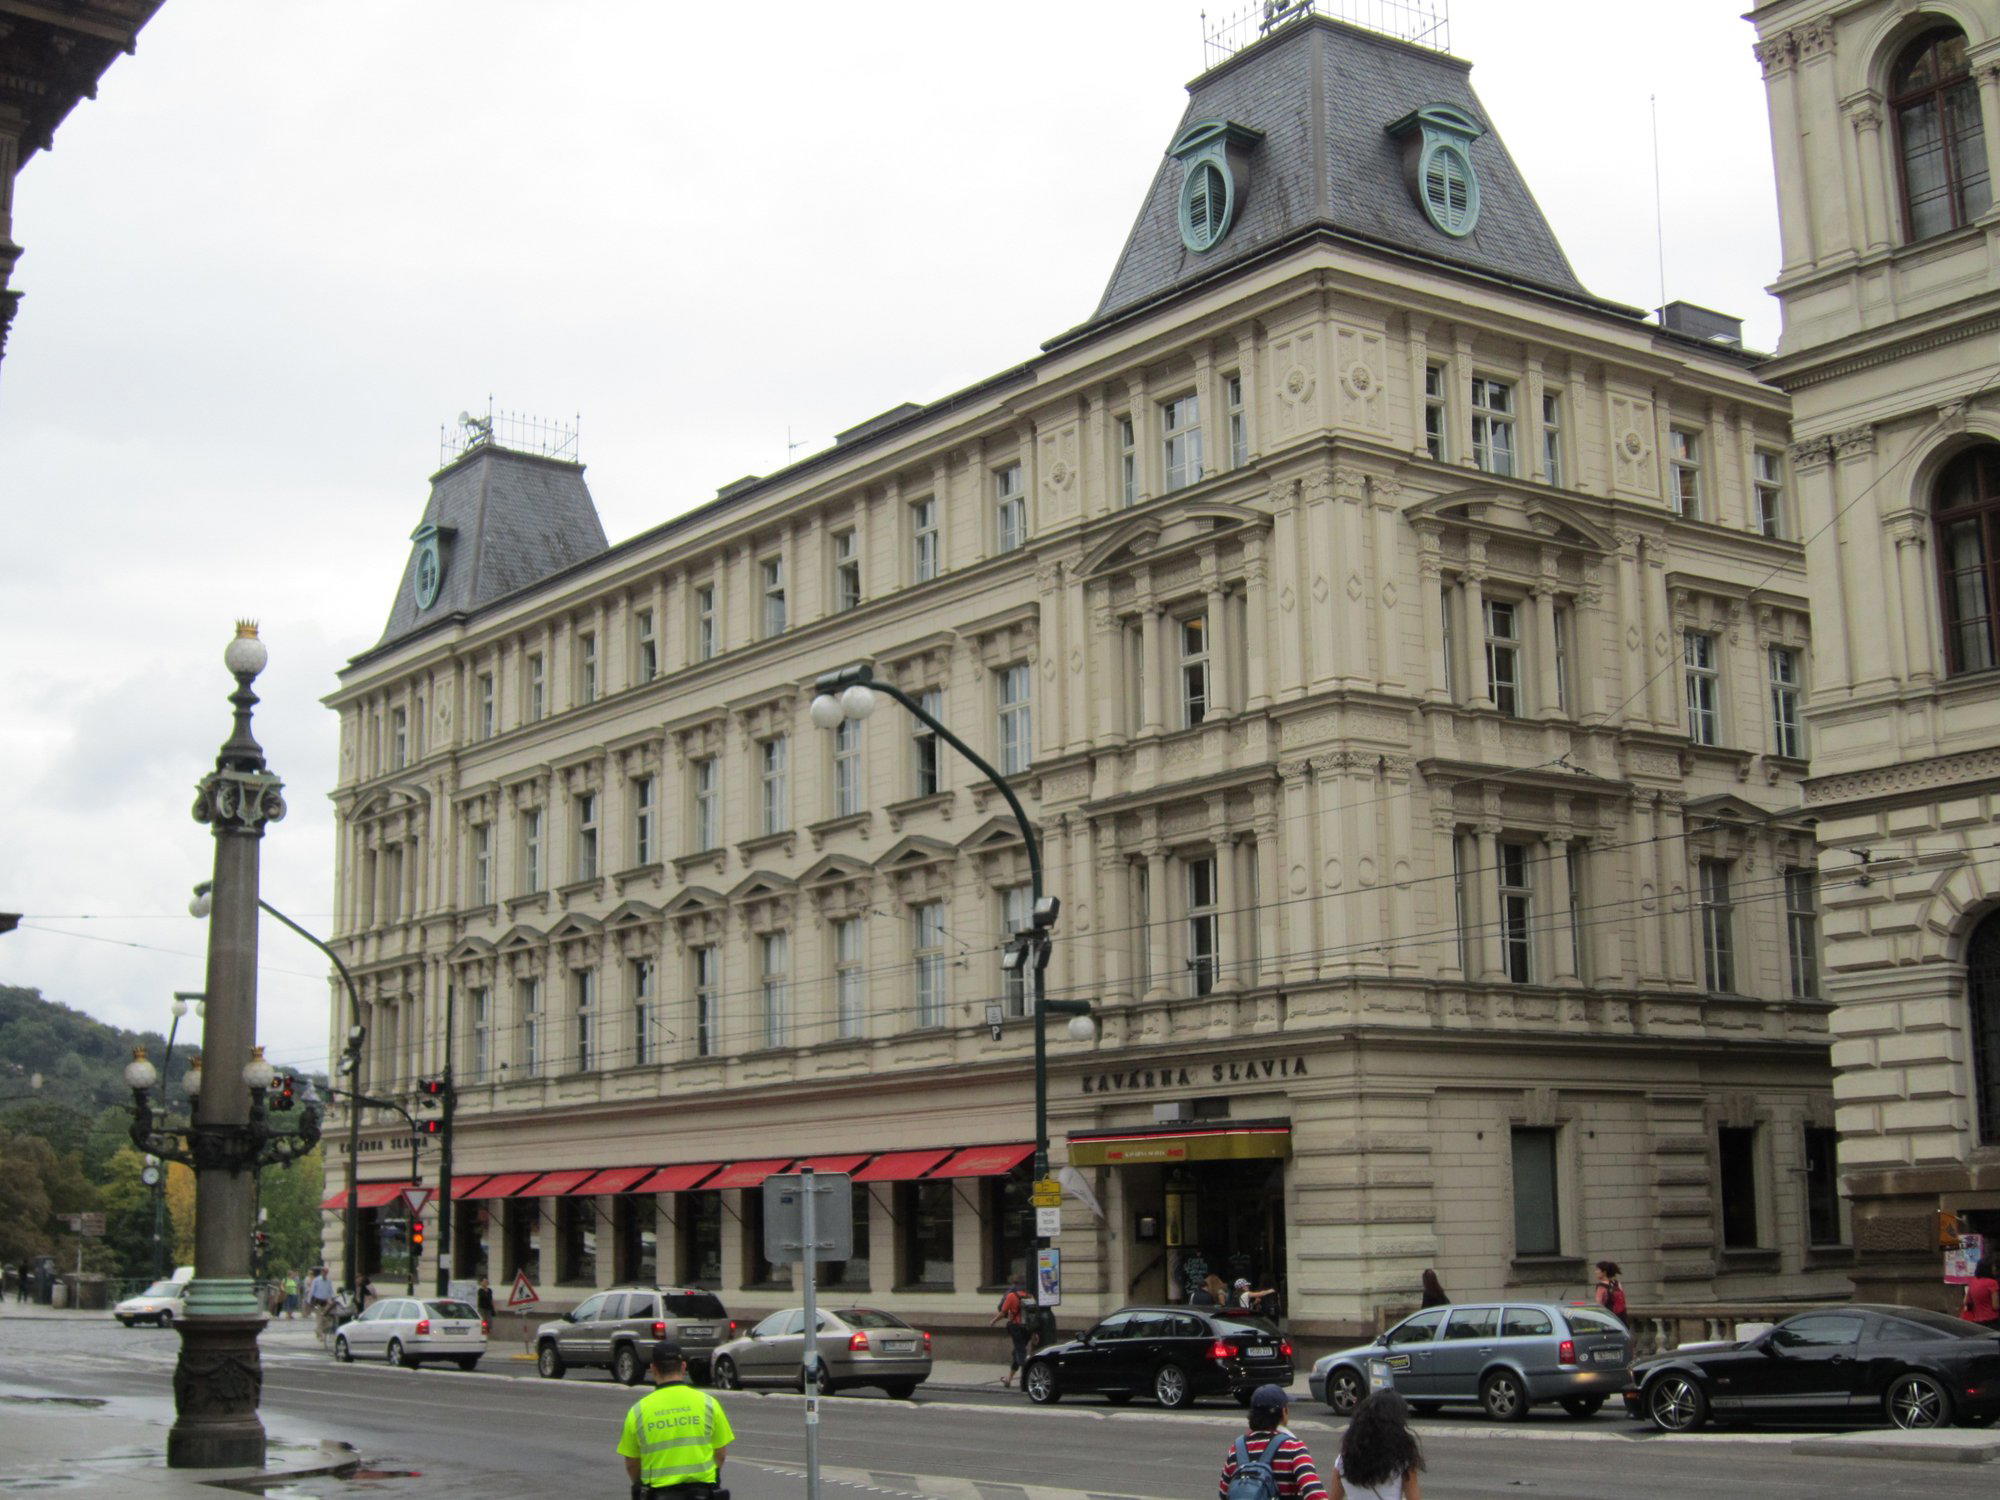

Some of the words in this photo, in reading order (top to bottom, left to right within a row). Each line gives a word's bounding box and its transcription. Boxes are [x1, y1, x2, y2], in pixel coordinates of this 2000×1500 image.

[1082, 1068, 1190, 1093] KAVÁRNA
[1212, 1057, 1308, 1082] SLAVIA
[340, 1139, 383, 1153] KAÁRNA
[647, 1416, 700, 1431] POLICIE
